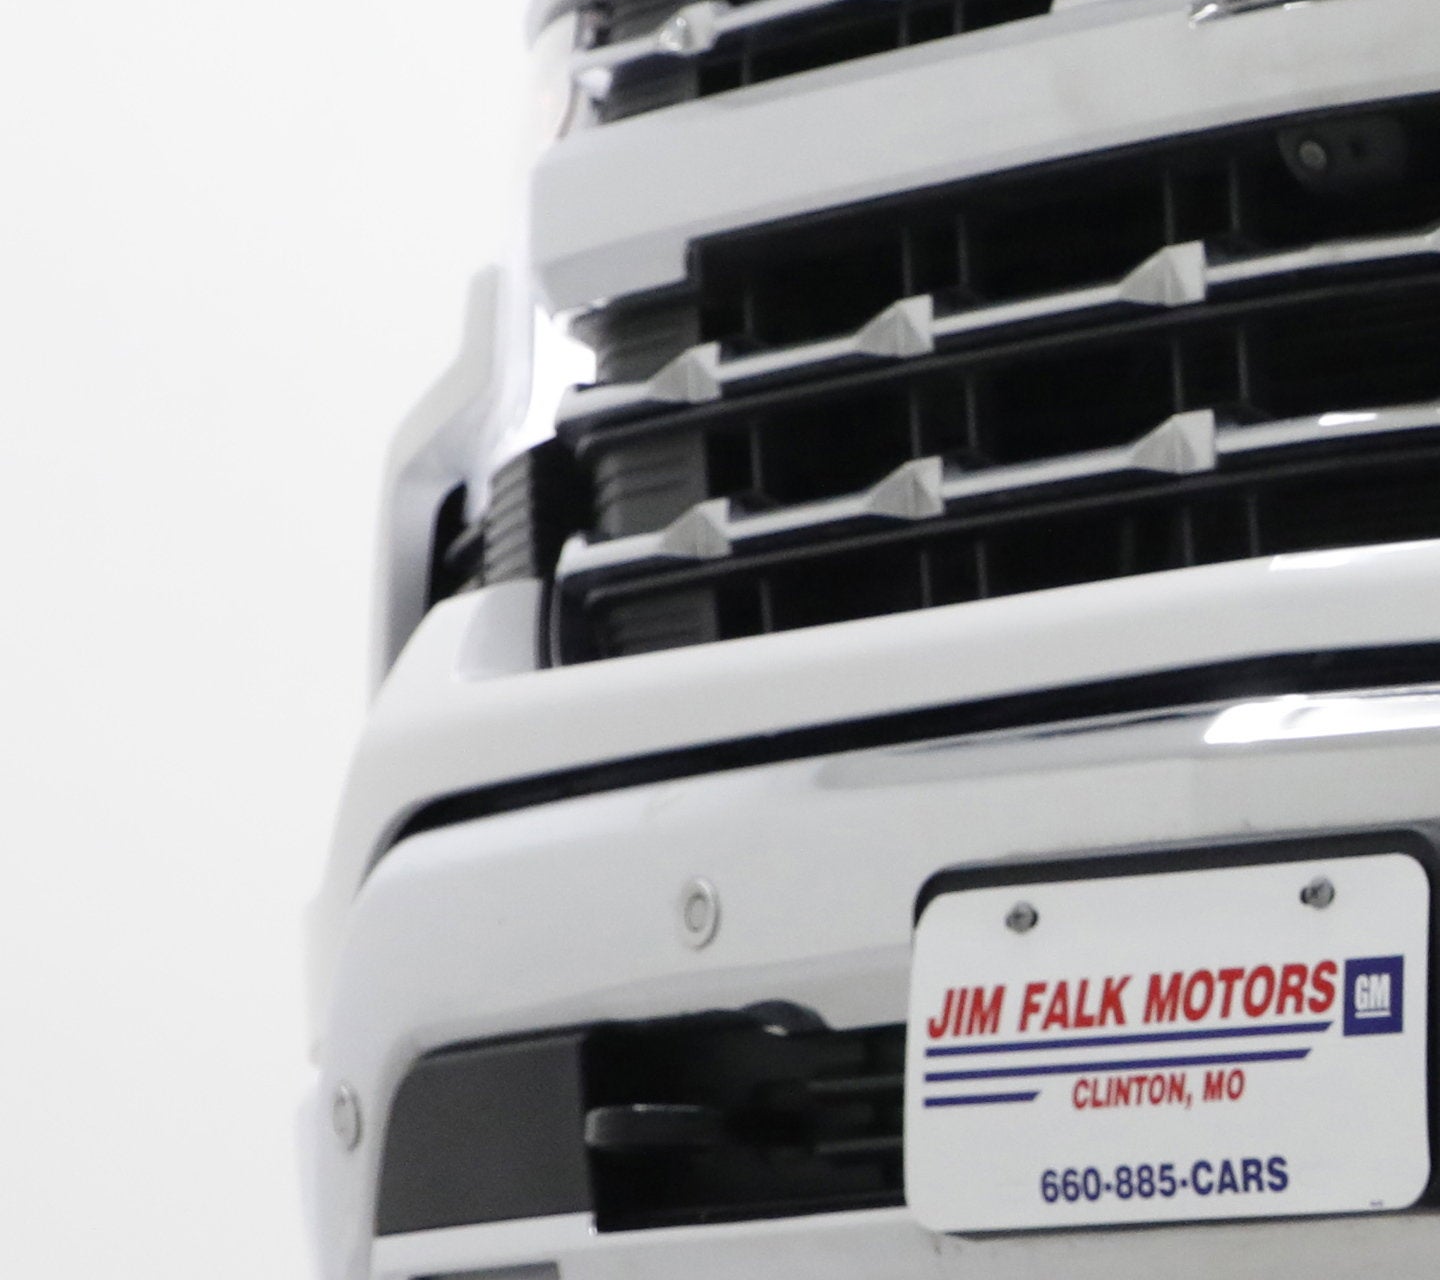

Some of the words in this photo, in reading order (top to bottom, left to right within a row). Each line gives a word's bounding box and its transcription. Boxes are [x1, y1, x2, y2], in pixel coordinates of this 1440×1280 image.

[927, 986, 1006, 1040] JIM
[1019, 976, 1131, 1032] FALK
[1143, 960, 1338, 1024] MOTORS
[1354, 972, 1391, 1012] GM
[1073, 1074, 1195, 1110] CLINTON,
[1203, 1068, 1245, 1101] MO
[1040, 1155, 1289, 1204] 660-885-CARS
